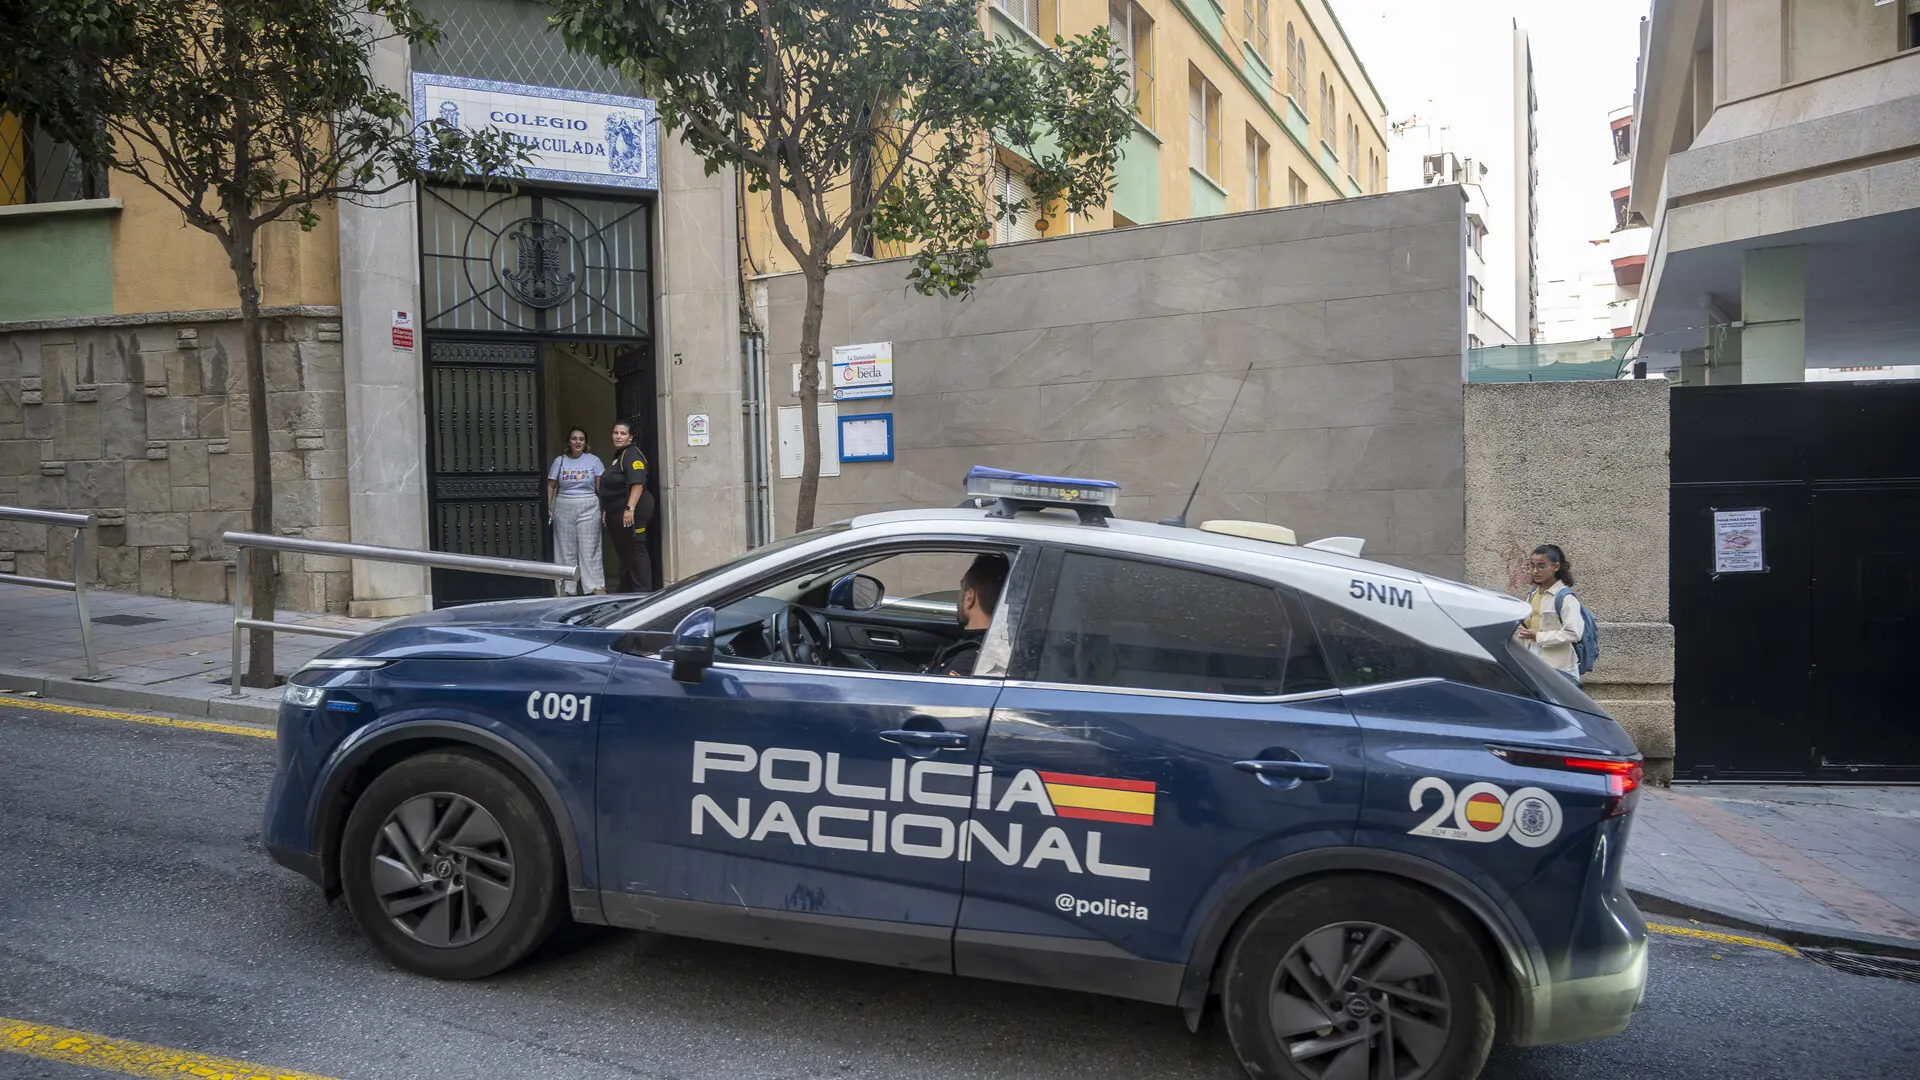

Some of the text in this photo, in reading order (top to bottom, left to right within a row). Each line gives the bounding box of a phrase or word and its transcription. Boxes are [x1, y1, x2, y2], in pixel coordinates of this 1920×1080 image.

[490, 111, 588, 131] COLEGIO
[508, 133, 606, 156] MACULADA
[1349, 579, 1413, 610] 5NM
[692, 740, 1057, 817] POLICIA
[1406, 776, 1563, 848] 200
[691, 794, 1151, 882] NACIONAL
[1054, 893, 1149, 922] @policia
